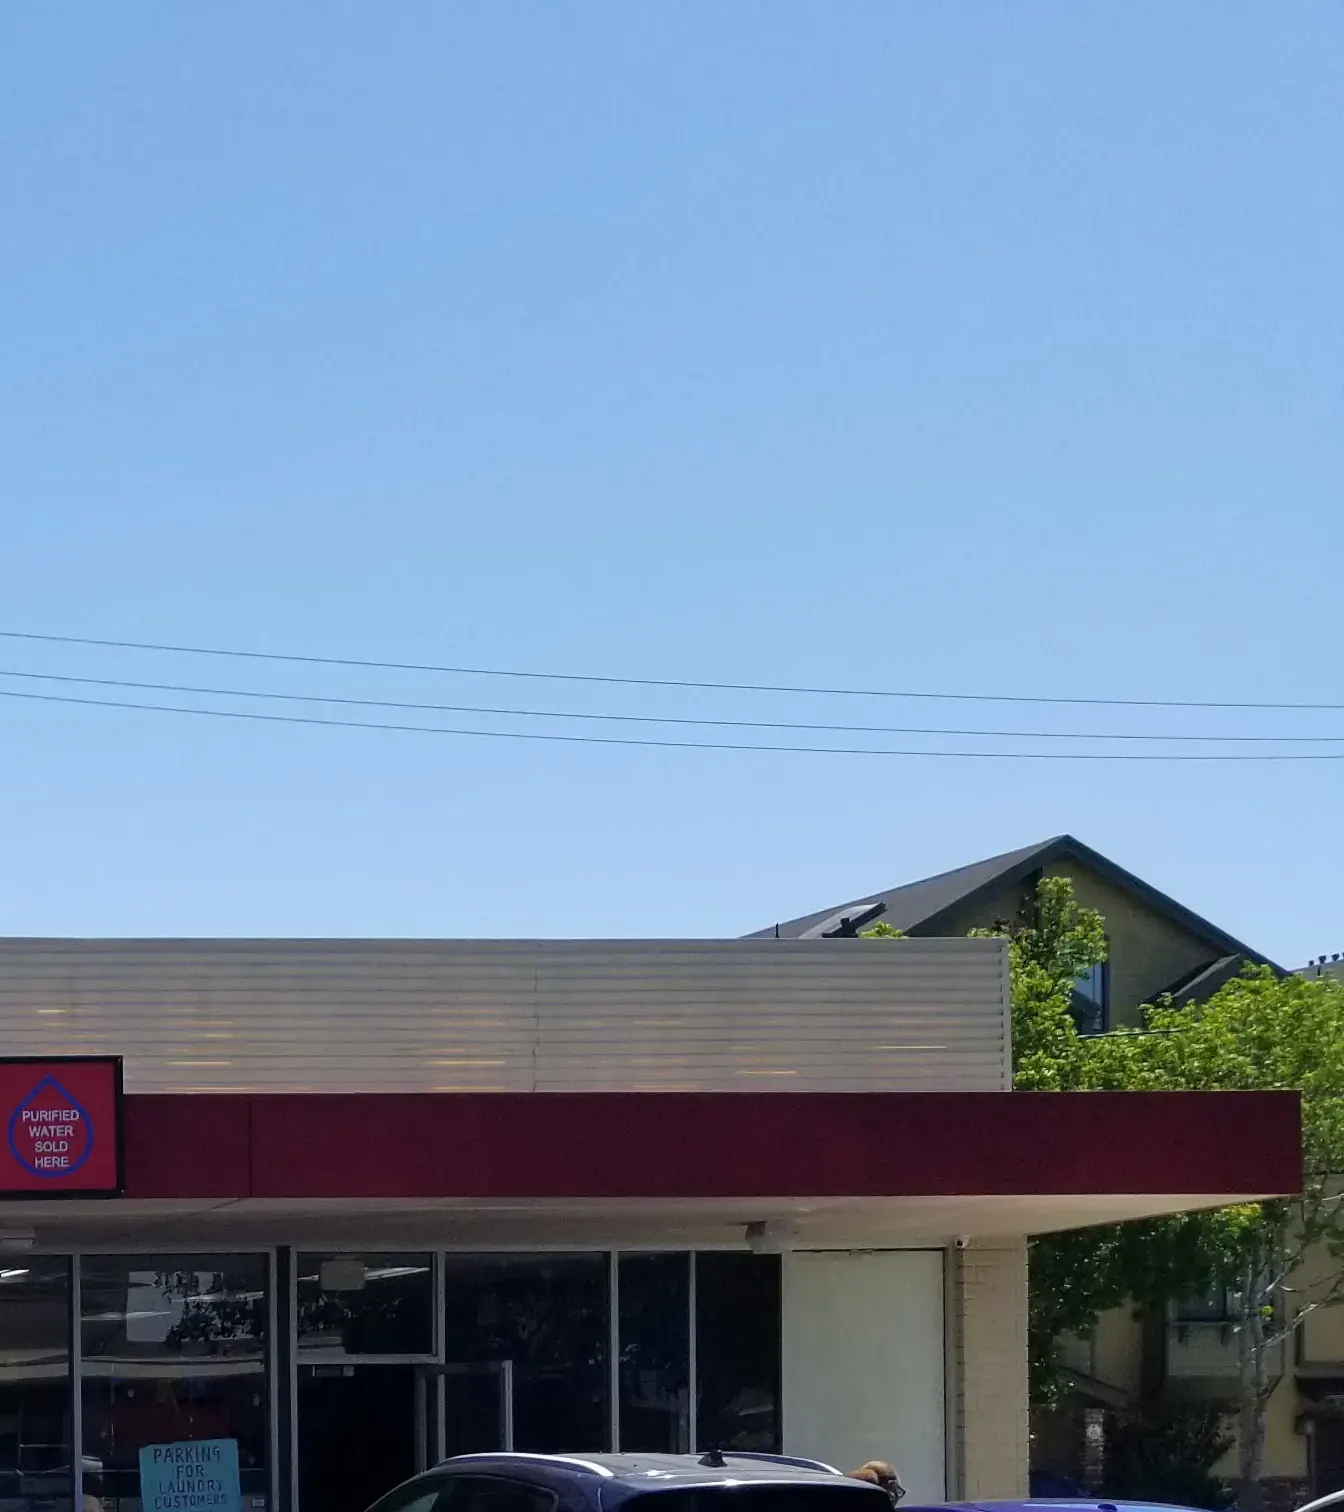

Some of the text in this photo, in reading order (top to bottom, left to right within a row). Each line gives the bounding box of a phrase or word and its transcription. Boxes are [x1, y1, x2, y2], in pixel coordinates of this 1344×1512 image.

[22, 1110, 79, 1121] PURIFIED
[29, 1126, 74, 1138] WATER
[35, 1141, 68, 1152] SOLD
[35, 1156, 69, 1168] HERE
[153, 1445, 220, 1463] PARKING
[176, 1465, 204, 1479] FOR
[159, 1480, 222, 1494] LAUNDRY
[154, 1494, 227, 1509] CUSTOMERS
